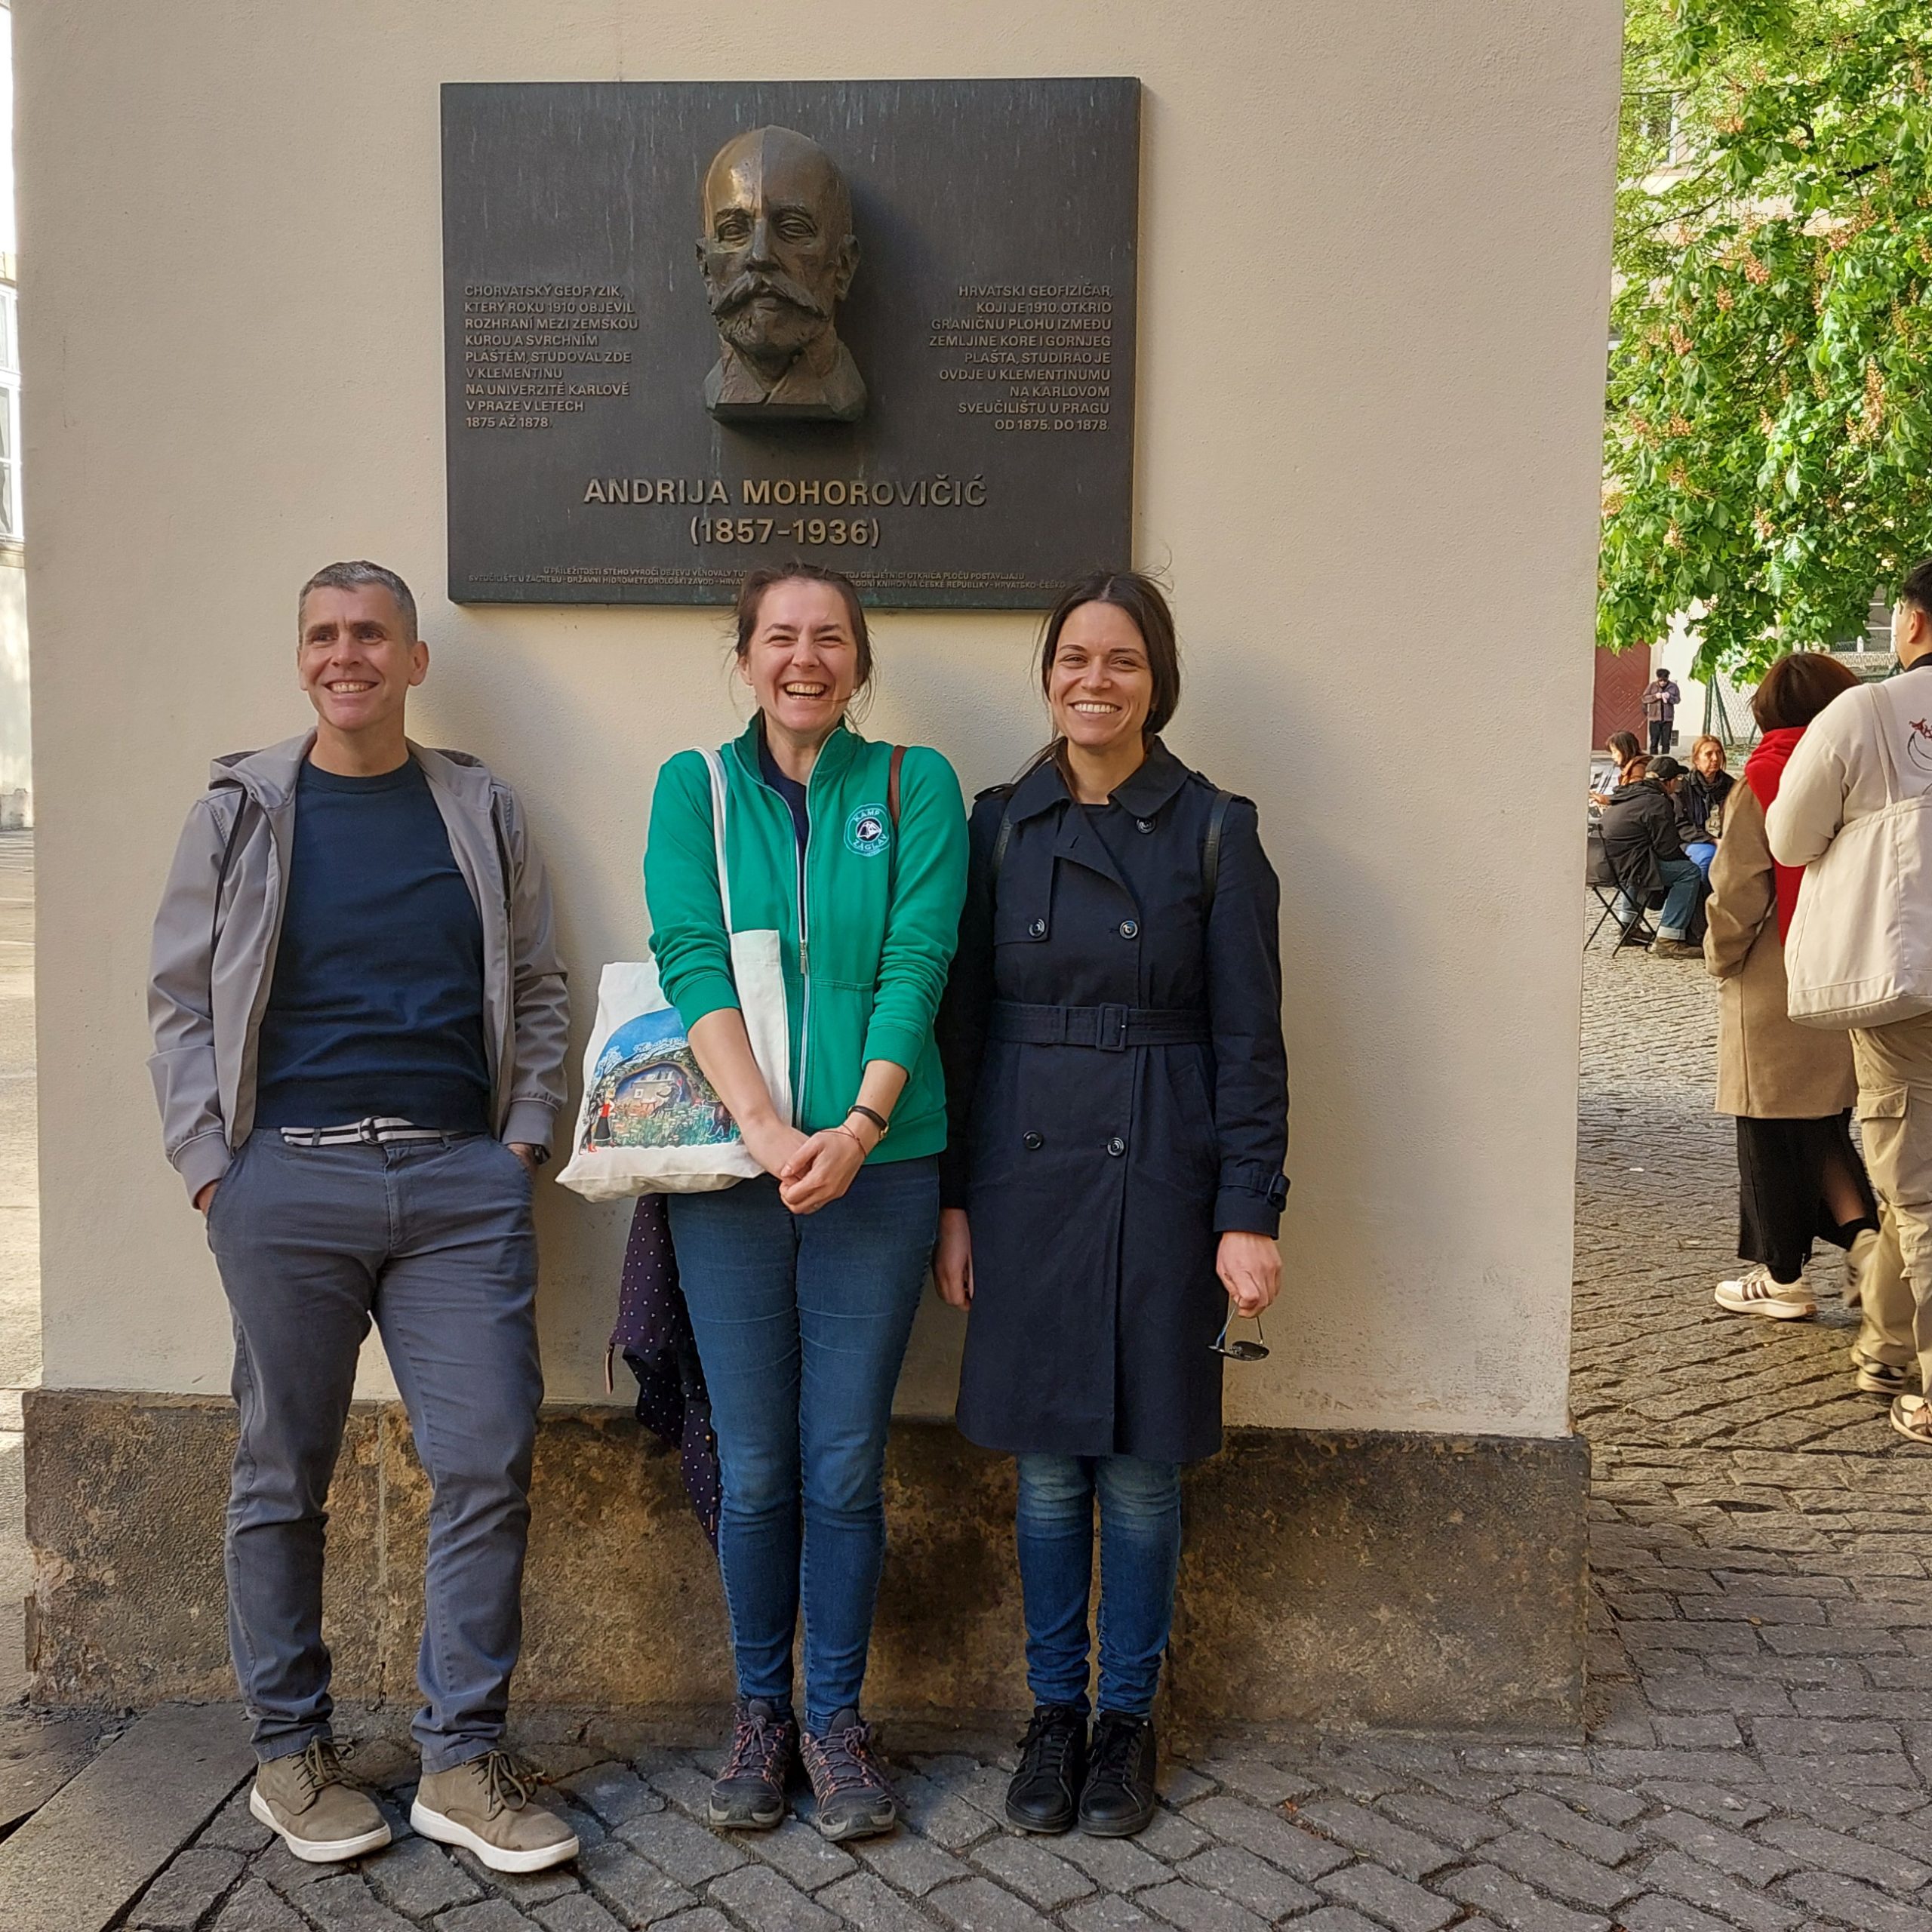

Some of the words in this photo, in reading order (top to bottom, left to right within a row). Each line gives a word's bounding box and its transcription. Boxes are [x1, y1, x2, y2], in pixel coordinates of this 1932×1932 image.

[465, 284, 551, 297] CHORVATSKÝ
[554, 285, 624, 298] GEOFYZIK,
[959, 285, 1025, 297] HRVATSKI
[1029, 282, 1113, 297] GEOFIZIČAR,
[465, 300, 505, 313] KTERÝ
[509, 302, 544, 313] ROKU
[548, 302, 575, 313] 1910
[580, 302, 635, 313] OBJEVIL
[977, 302, 1006, 314] KOJI
[1010, 302, 1026, 314] JE
[1061, 302, 1112, 314] OTKRIO
[465, 316, 534, 330] ROZHRANÍ
[537, 318, 568, 330] MEZI
[573, 318, 638, 330] ZEMSKOU
[931, 316, 1004, 331] GRANIČNU
[1008, 319, 1054, 331] PLOHU
[1057, 319, 1112, 330] IZMEĐU
[514, 335, 524, 346] A
[526, 333, 598, 346] SVRCHNÍM
[929, 336, 996, 346] ZEMLJINE
[1001, 336, 1036, 346] KORE
[1040, 336, 1044, 346] I
[1046, 336, 1111, 346] GORNJEG
[531, 352, 601, 362] STUDOVAL
[605, 352, 632, 362] ZDE
[964, 349, 1019, 365] PLAŠTA,
[1022, 352, 1092, 364] STUDIRAO
[1094, 352, 1111, 364] JE
[466, 368, 476, 378] V
[478, 368, 563, 378] KLEMENTINU
[940, 369, 983, 380] OVDJE
[988, 369, 996, 380] U
[1000, 369, 1110, 380] KLEMENTINUMU
[466, 384, 485, 395] NA
[488, 382, 565, 395] UNIVERZITĚ
[569, 382, 629, 395] KARLOVĚ
[1011, 386, 1029, 397] NA
[1032, 386, 1110, 397] KARLOVOM
[466, 401, 477, 411] V
[478, 401, 520, 411] PRAZE
[524, 401, 533, 411] V
[535, 401, 584, 411] LETECH
[958, 400, 1045, 414] SVEUČILIŠTU
[1050, 403, 1059, 414] U
[1062, 403, 1109, 414] PRAGU
[466, 417, 495, 428] 1875
[499, 414, 516, 428] AŽ
[995, 420, 1014, 430] OD
[1017, 420, 1050, 431] 1875.
[1054, 420, 1074, 430] DO
[583, 478, 729, 505] ANDRIJA
[743, 474, 987, 507] MOHOROVIČIĆ
[691, 517, 881, 547] (1857-1936)
[854, 809, 880, 823] KAMP
